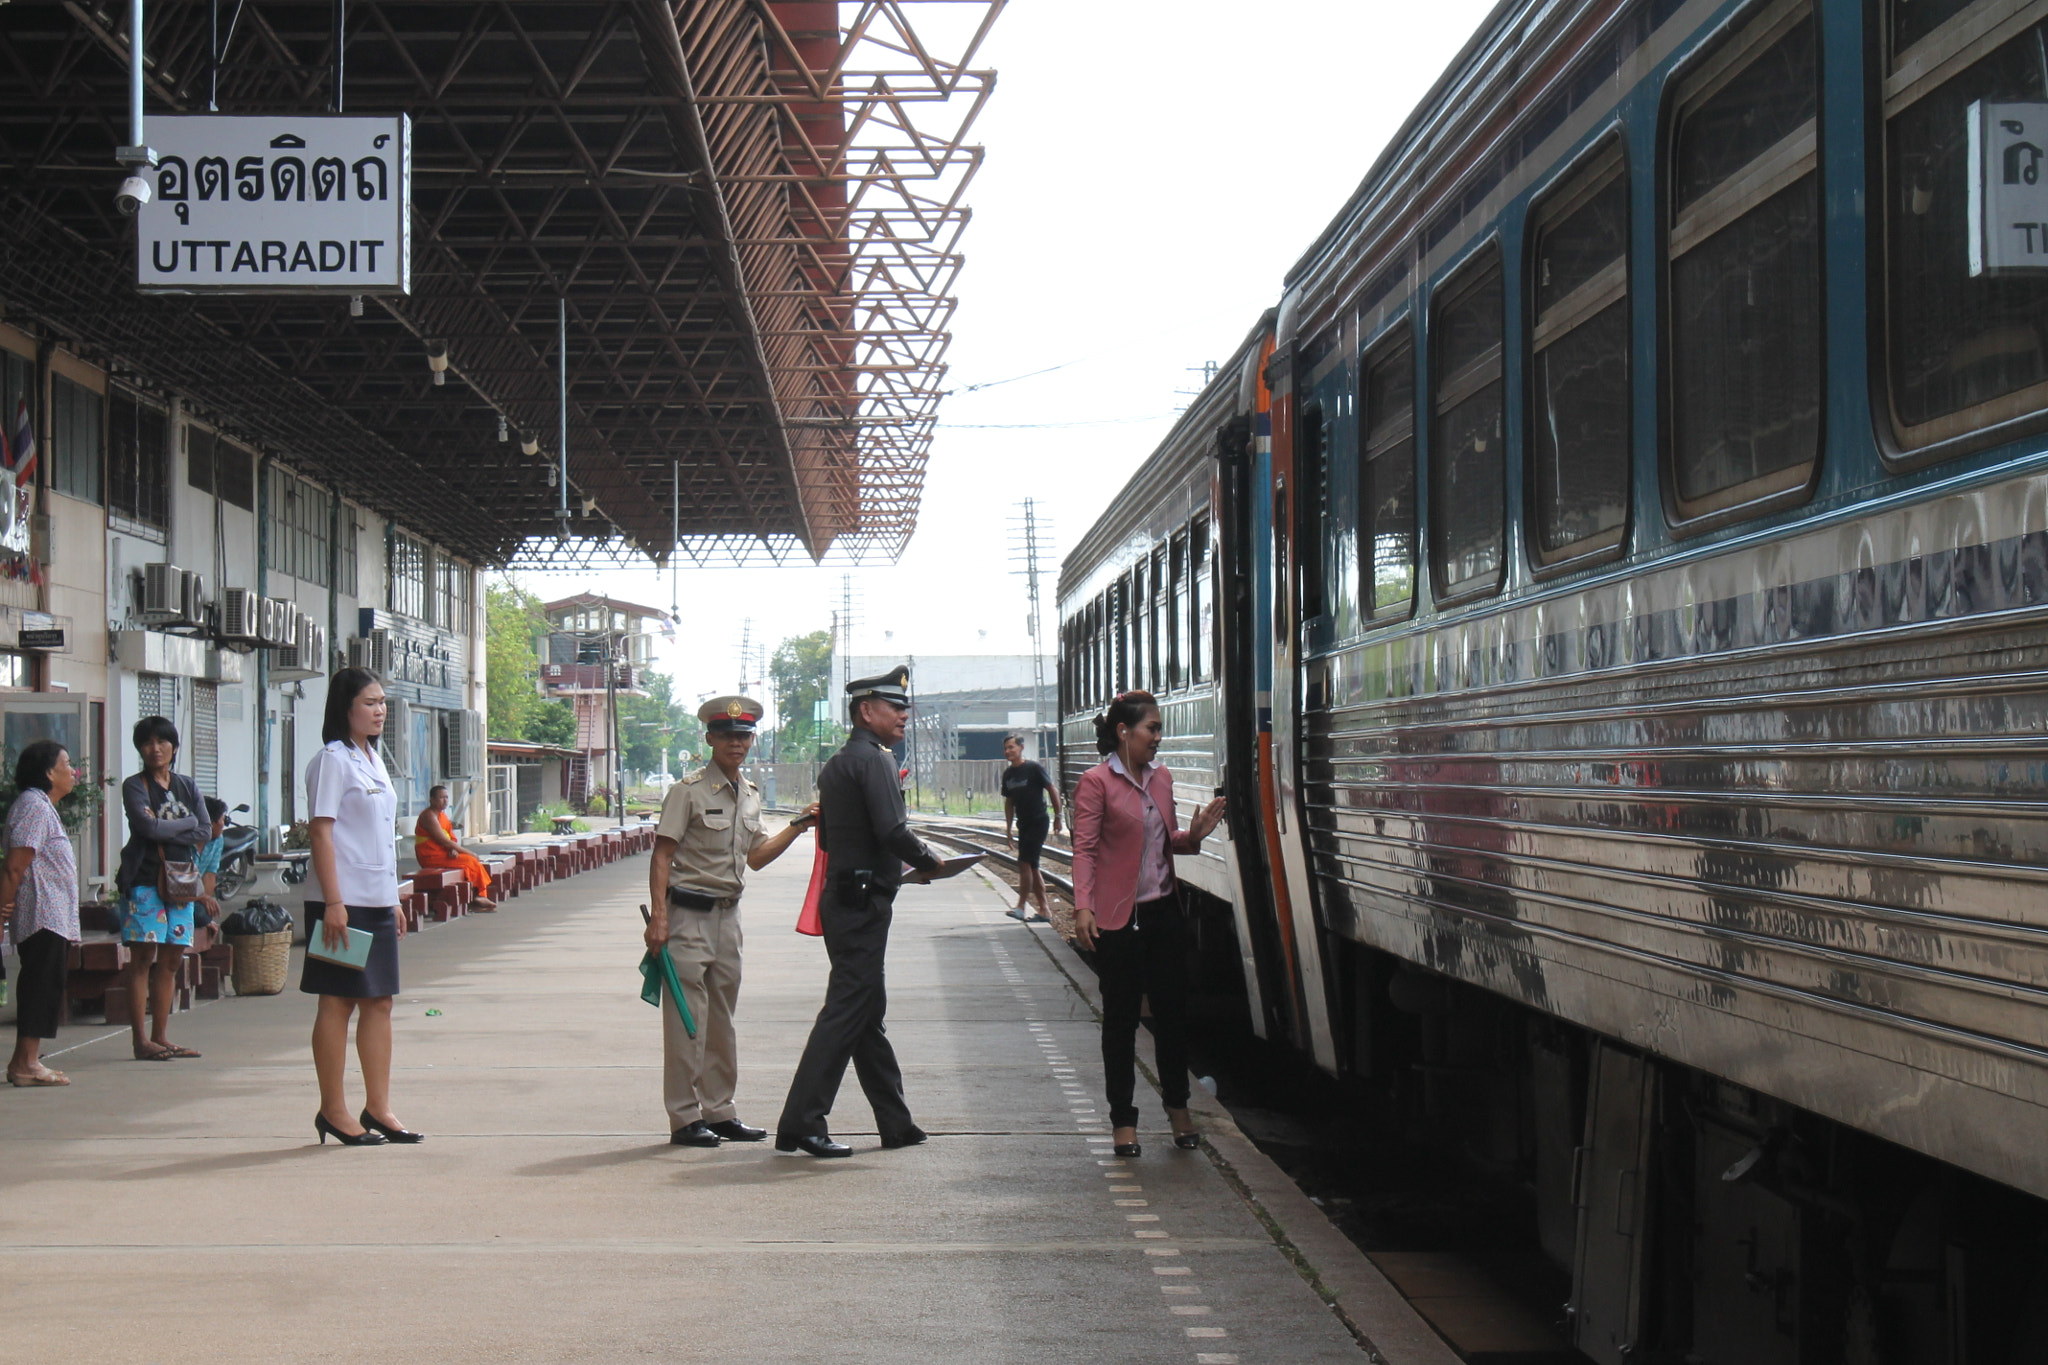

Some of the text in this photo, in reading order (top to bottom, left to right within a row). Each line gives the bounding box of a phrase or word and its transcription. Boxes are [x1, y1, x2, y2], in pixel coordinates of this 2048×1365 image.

[153, 133, 390, 225] อุตรดิตถ์
[152, 240, 384, 273] UTTARADIT
